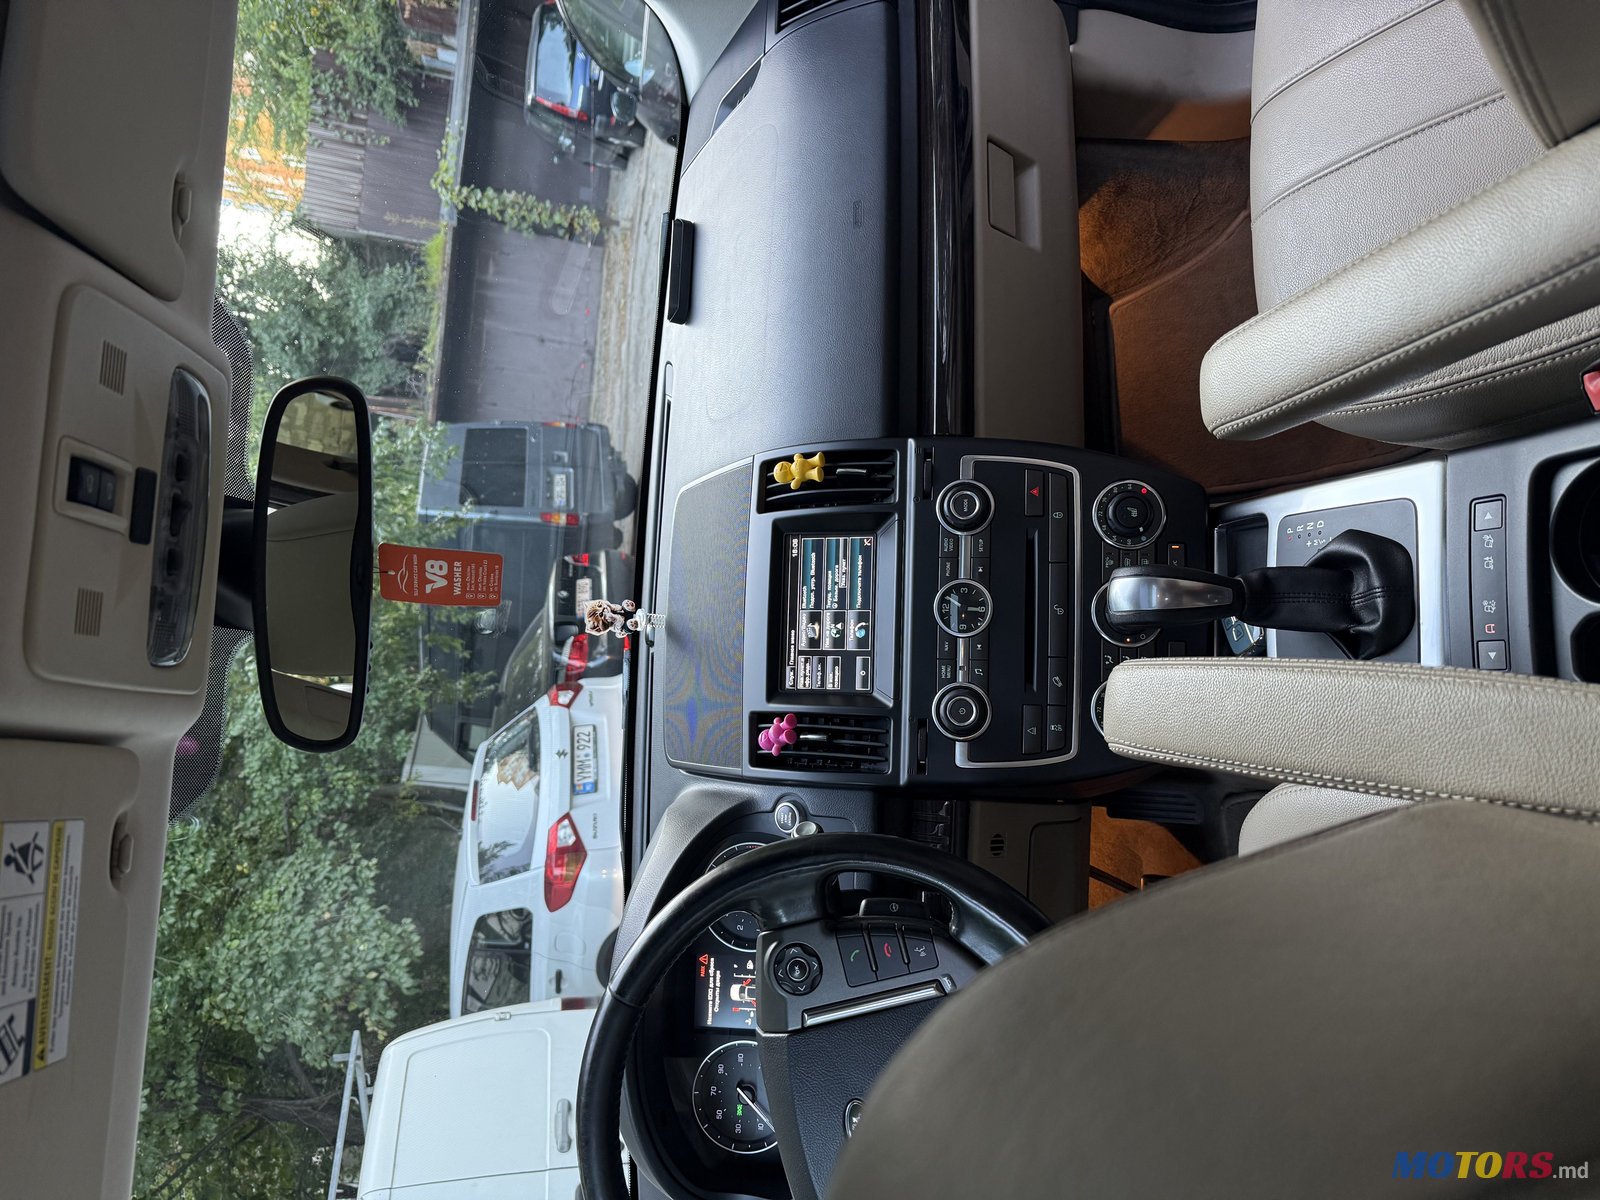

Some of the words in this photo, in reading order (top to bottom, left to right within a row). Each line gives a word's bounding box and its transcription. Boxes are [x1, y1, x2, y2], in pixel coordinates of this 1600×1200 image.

[1307, 522, 1314, 530] N
[1317, 520, 1324, 528] D
[425, 560, 448, 594] V8
[454, 562, 462, 595] WASHER
[942, 604, 949, 613] 12
[576, 731, 591, 750] 922
[574, 759, 592, 782] YMM
[718, 1064, 724, 1074] 90
[710, 1086, 717, 1096] 70
[716, 1109, 722, 1119] 50
[735, 1123, 741, 1133] 30
